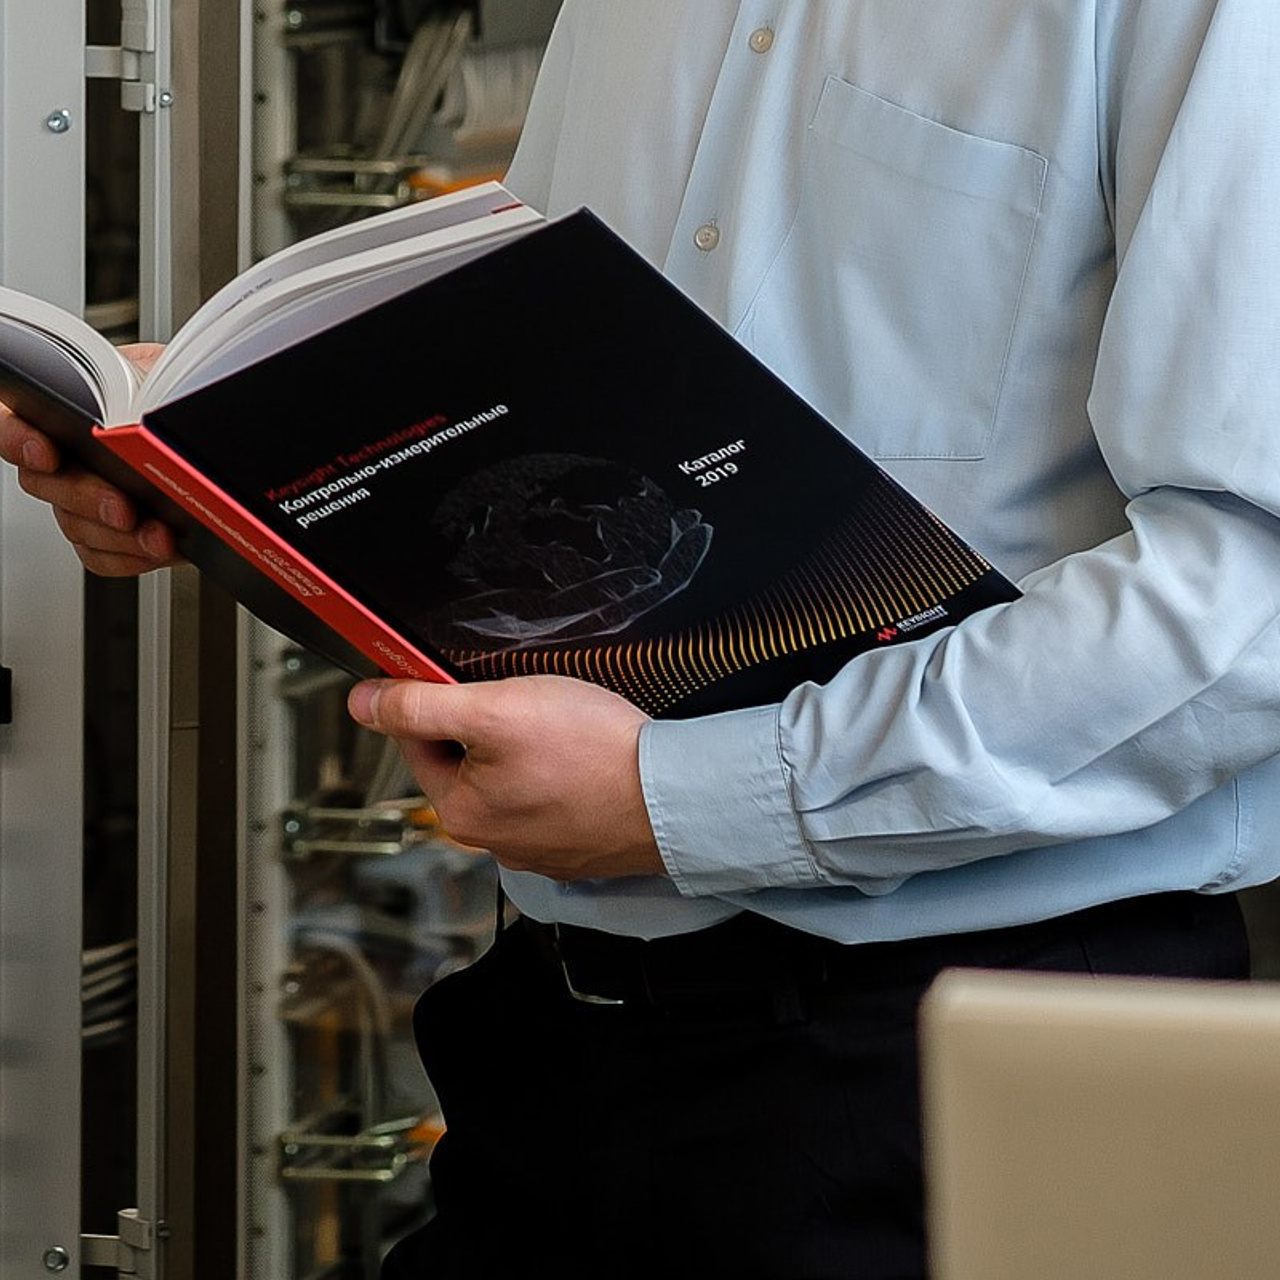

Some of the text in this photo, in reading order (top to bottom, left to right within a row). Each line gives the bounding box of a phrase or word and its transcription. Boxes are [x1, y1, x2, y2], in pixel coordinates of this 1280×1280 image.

[278, 403, 509, 515] Контрольно-измерительные
[678, 439, 746, 475] Каталог
[695, 462, 739, 488] 2019
[296, 487, 371, 529] решения
